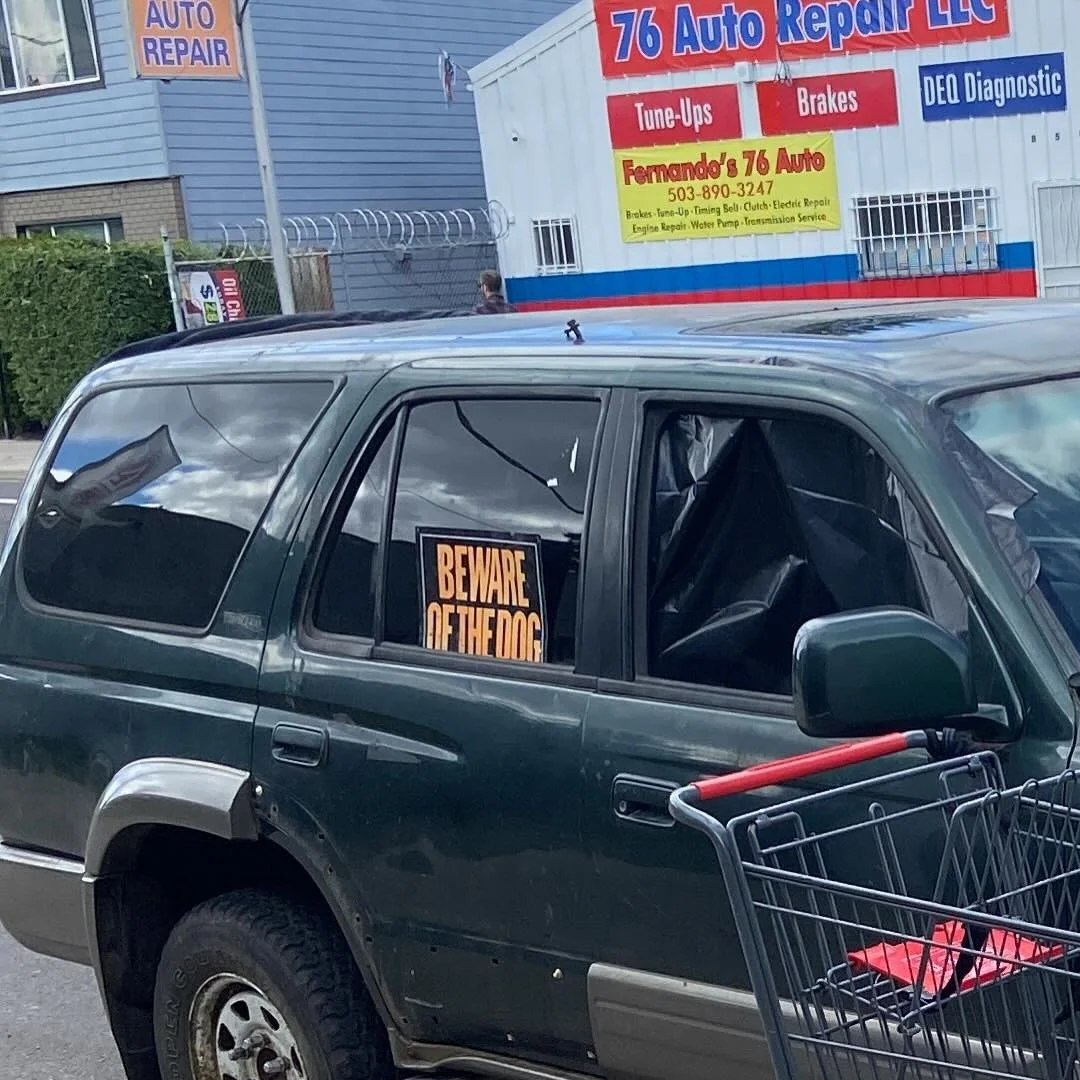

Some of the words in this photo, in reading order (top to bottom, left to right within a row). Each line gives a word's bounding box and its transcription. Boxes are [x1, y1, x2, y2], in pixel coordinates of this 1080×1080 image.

[145, 0, 215, 30] AUTO
[611, 7, 663, 63] 76
[673, 3, 765, 56] Auto
[776, 0, 914, 50] Repair
[142, 36, 231, 67] REPAIR
[797, 85, 859, 118] Brakes
[923, 73, 960, 107] DEQ
[964, 65, 1063, 107] Diagnostic
[635, 97, 713, 133] Tune-Ups
[622, 152, 738, 186] Fernando's
[742, 149, 770, 177] 76
[775, 147, 826, 174] Auto
[668, 179, 774, 202] 503-890-3247
[626, 208, 652, 220] Brakes
[656, 206, 690, 219] Tune-Up
[694, 205, 721, 216] Timing
[743, 201, 769, 212] Clutch
[773, 198, 801, 210] Electric
[803, 196, 831, 208] Repair
[632, 223, 659, 235] Engine
[660, 221, 687, 233] Repair
[690, 220, 715, 230] Water
[717, 218, 740, 229] Pump
[744, 214, 796, 227] Transmission
[797, 212, 827, 223] Service
[222, 278, 238, 296] Oil
[437, 543, 530, 608] BEWARE
[426, 602, 455, 651] OF
[456, 604, 496, 658] THE
[496, 608, 542, 663] DOG
